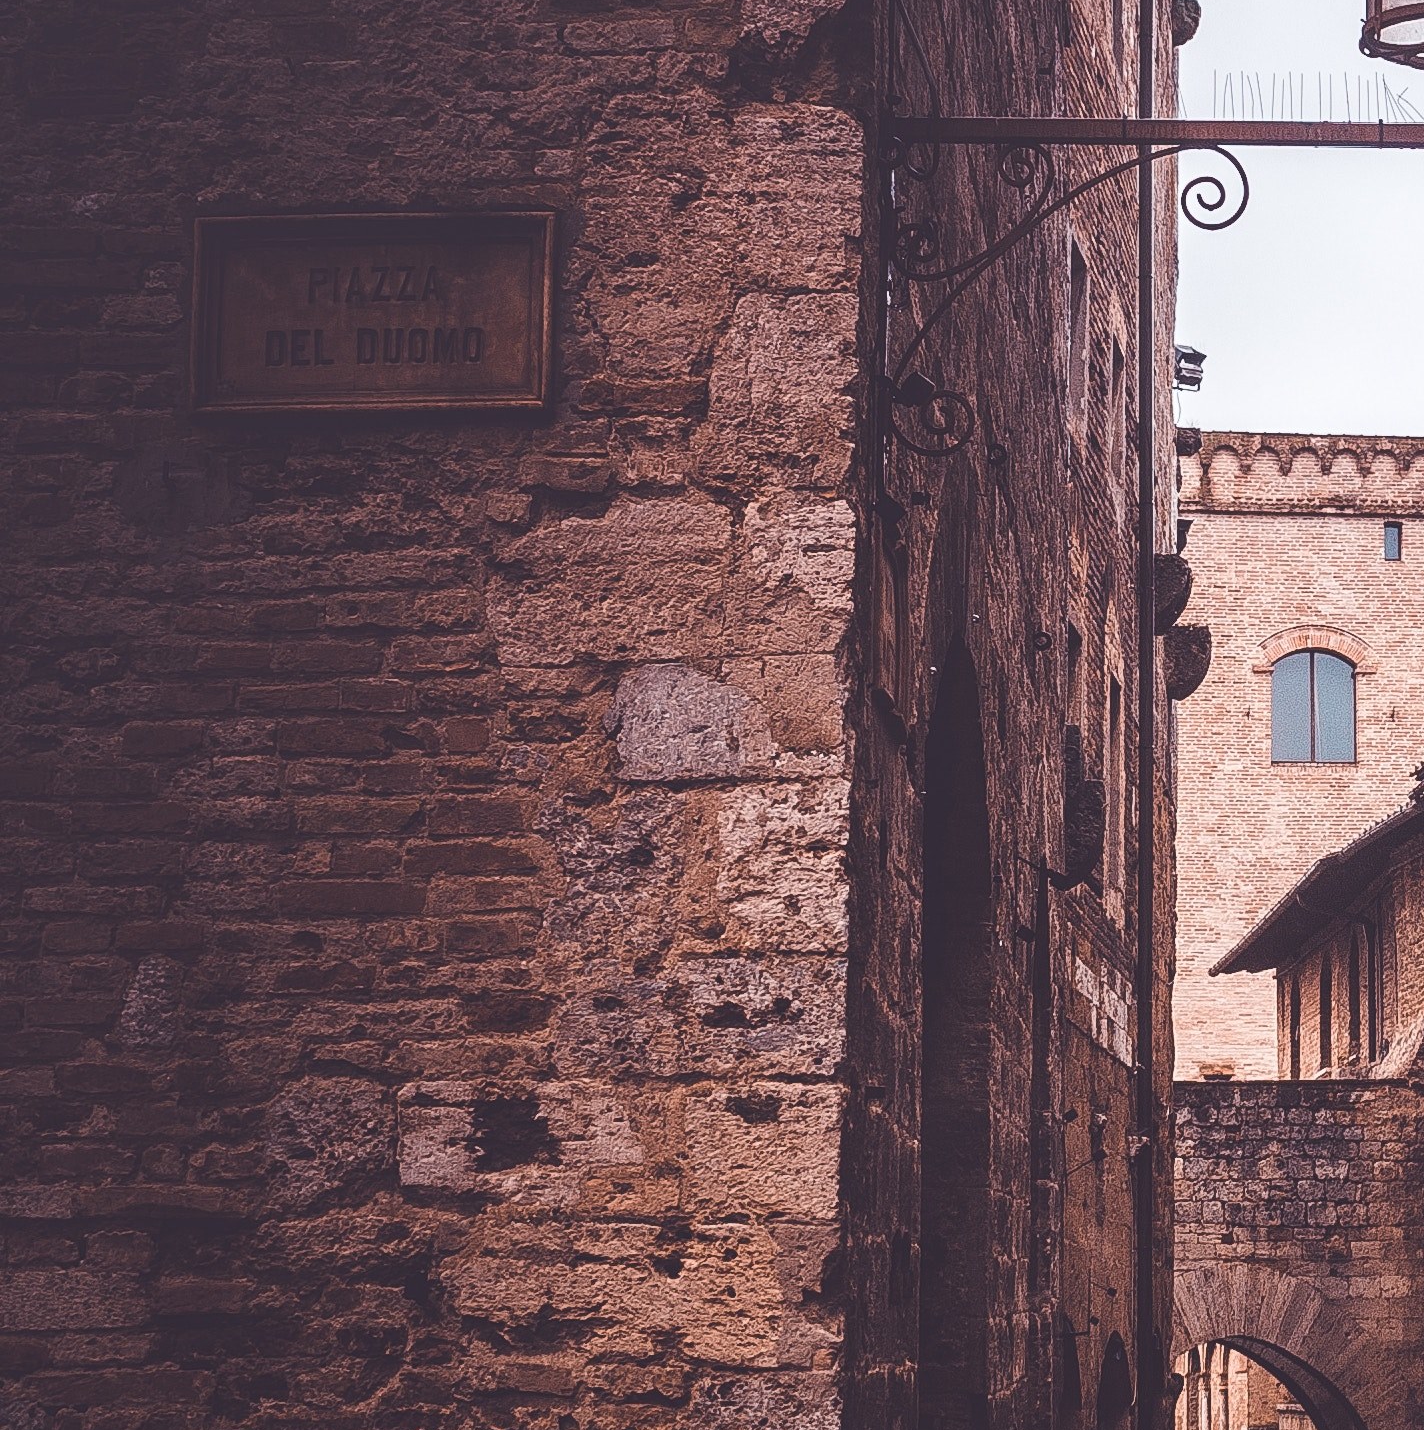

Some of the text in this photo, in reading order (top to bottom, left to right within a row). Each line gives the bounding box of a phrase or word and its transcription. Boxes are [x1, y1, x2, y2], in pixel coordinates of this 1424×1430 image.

[308, 265, 441, 304] PIAZZA
[265, 327, 484, 366] DEL DUOMO
